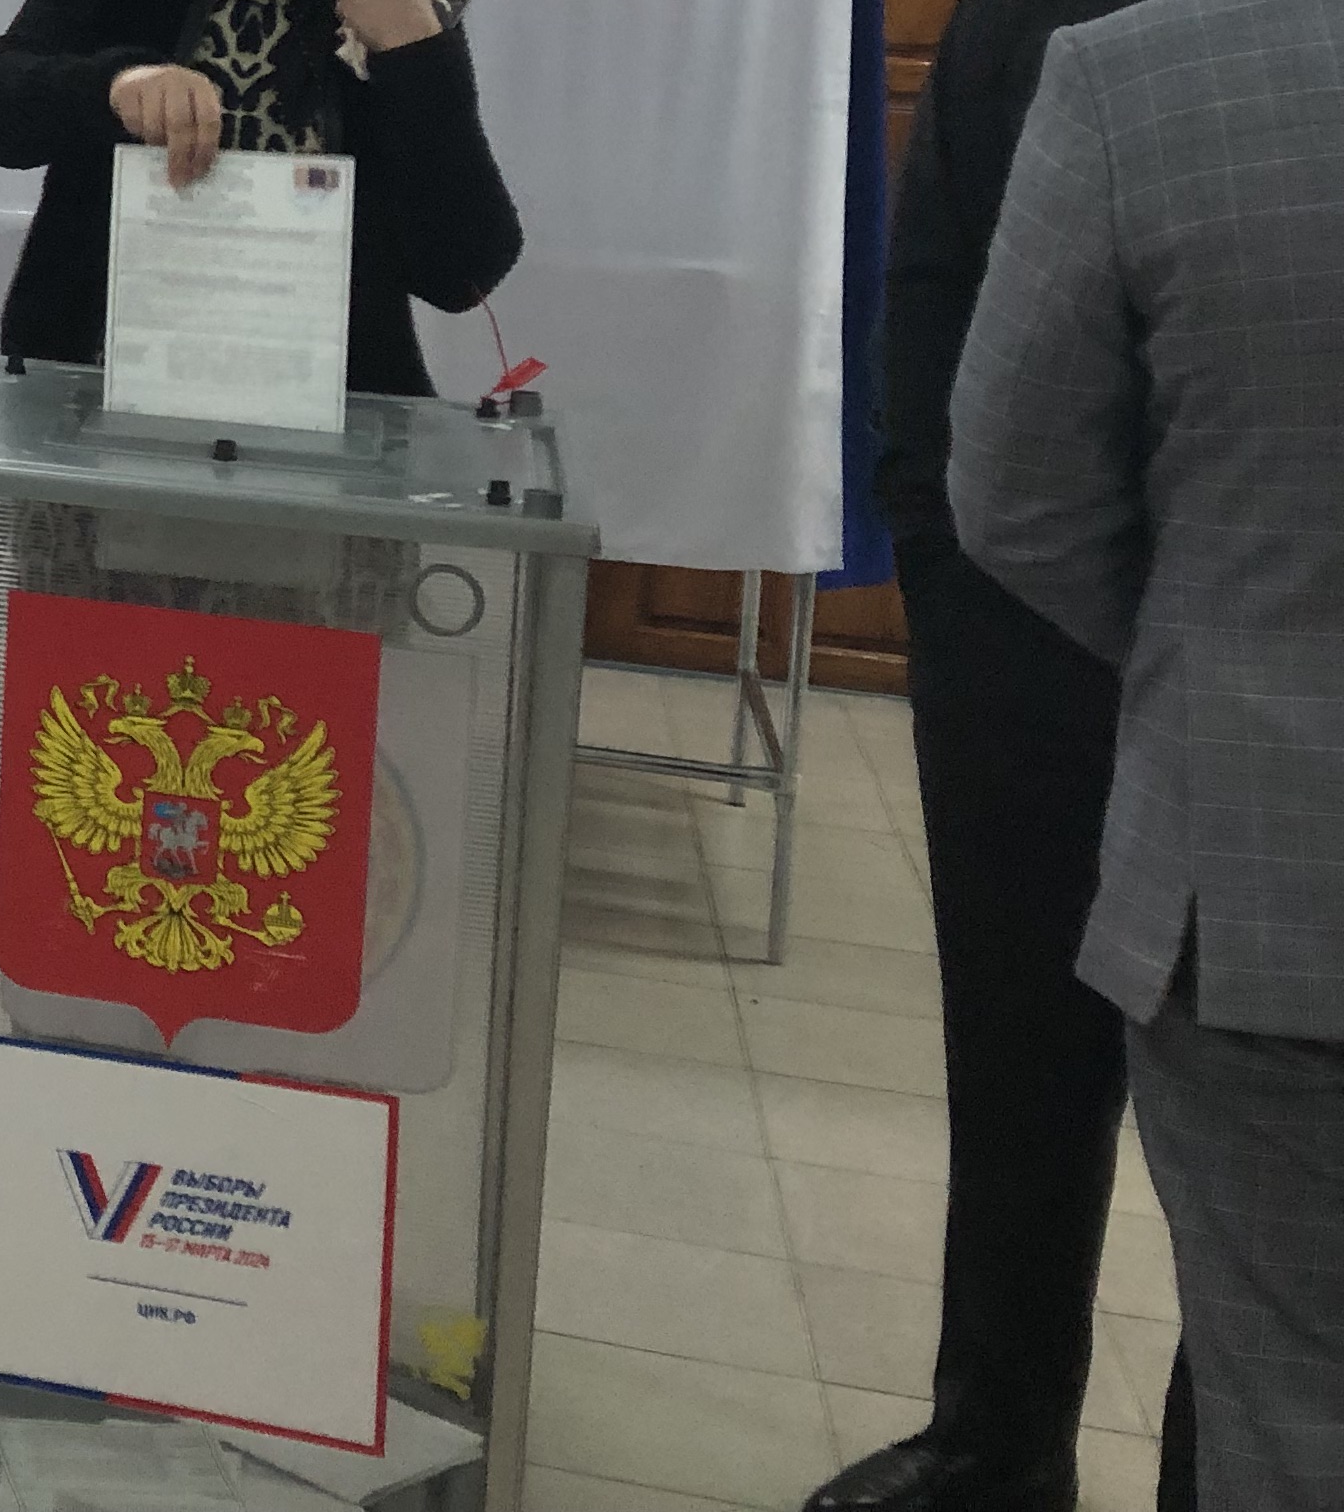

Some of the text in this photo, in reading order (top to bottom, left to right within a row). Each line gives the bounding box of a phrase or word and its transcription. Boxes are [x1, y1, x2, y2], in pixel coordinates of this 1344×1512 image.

[171, 1168, 266, 1199] ВЫБОРЫ
[160, 1191, 292, 1228] ПРЕЗИДЕНТА
[147, 1211, 233, 1241] РОССИИ
